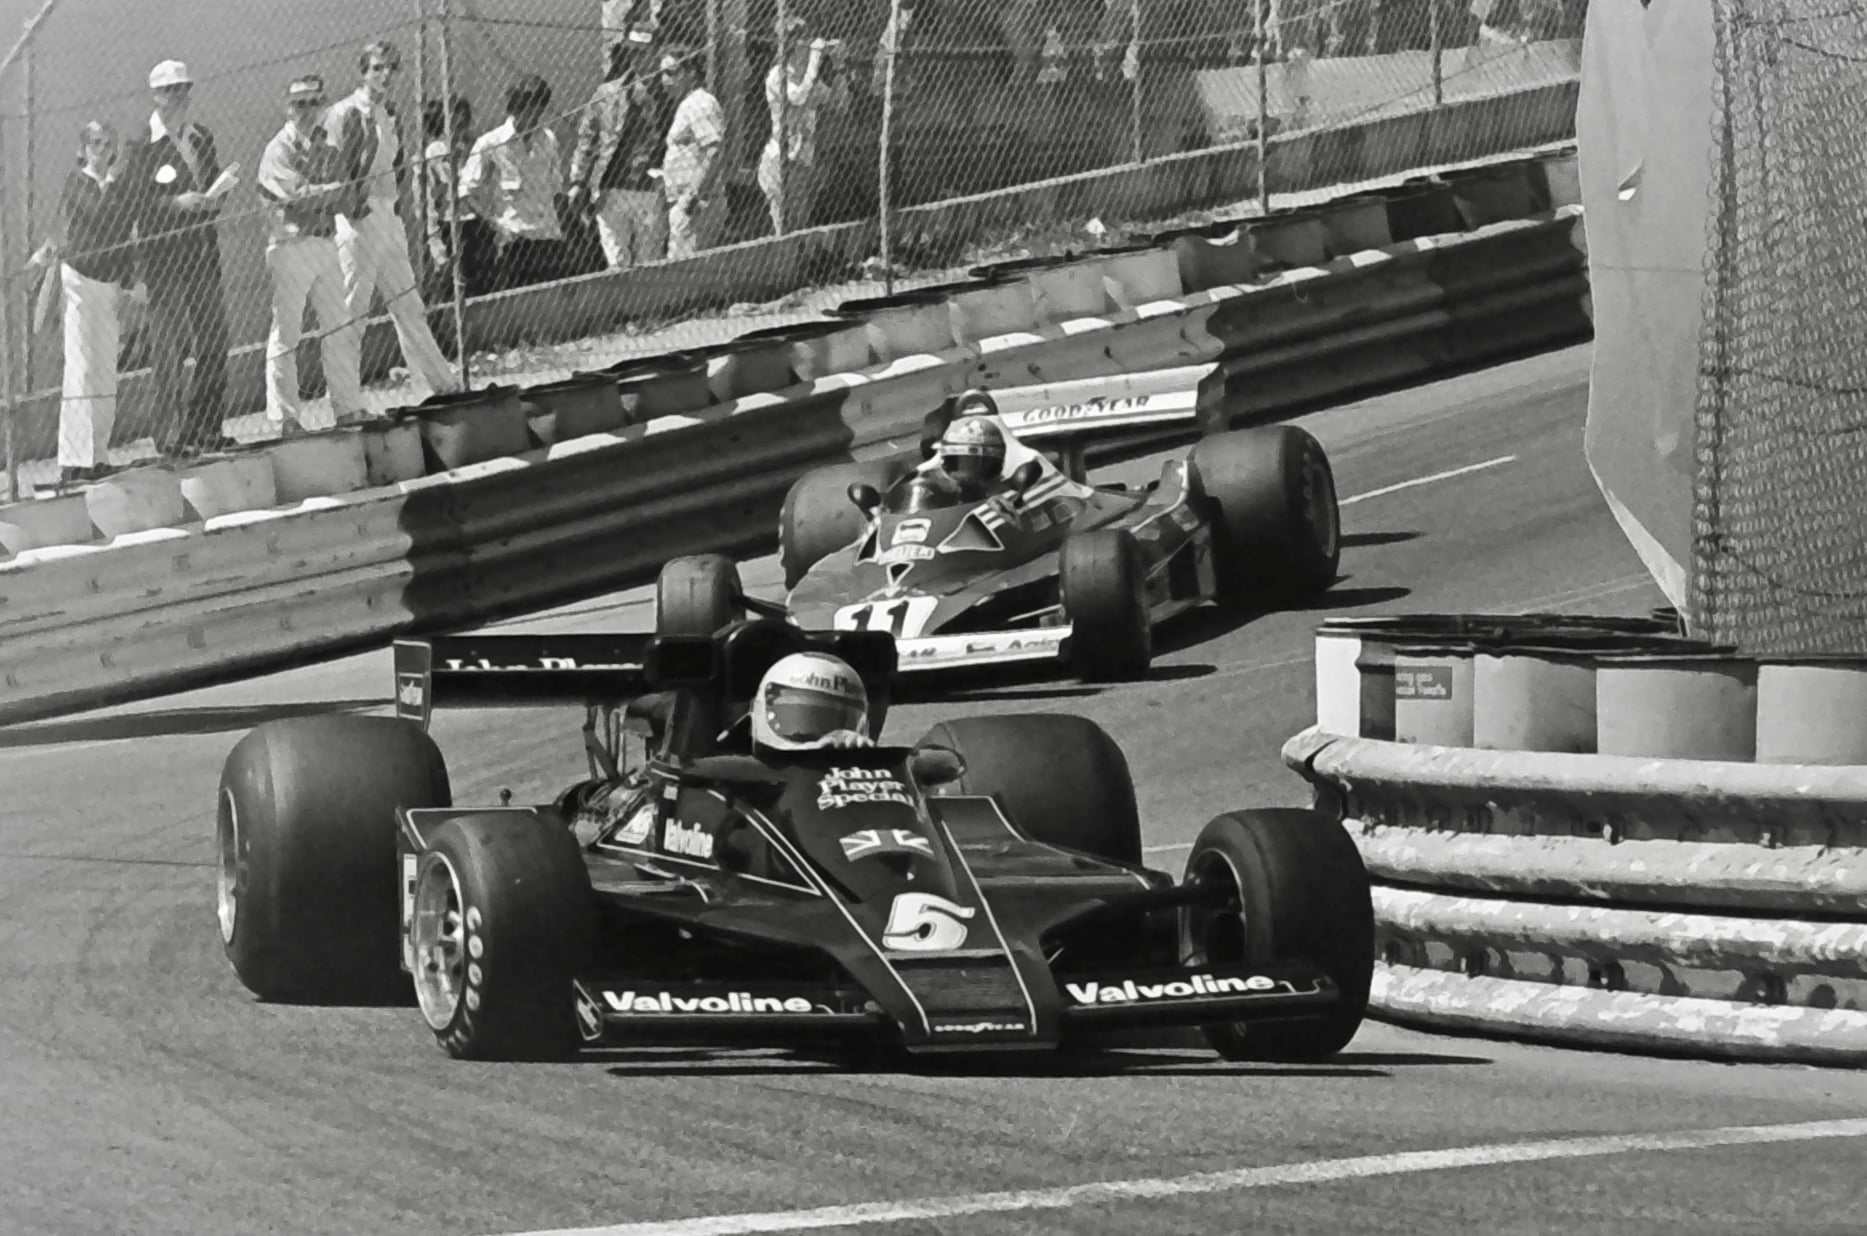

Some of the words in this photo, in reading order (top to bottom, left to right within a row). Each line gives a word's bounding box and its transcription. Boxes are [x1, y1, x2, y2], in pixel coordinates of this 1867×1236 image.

[824, 766, 893, 780] John
[817, 778, 905, 795] Player
[882, 892, 975, 950] 5
[1066, 973, 1275, 1004] Valvoline
[602, 990, 812, 1013] Valvoline
